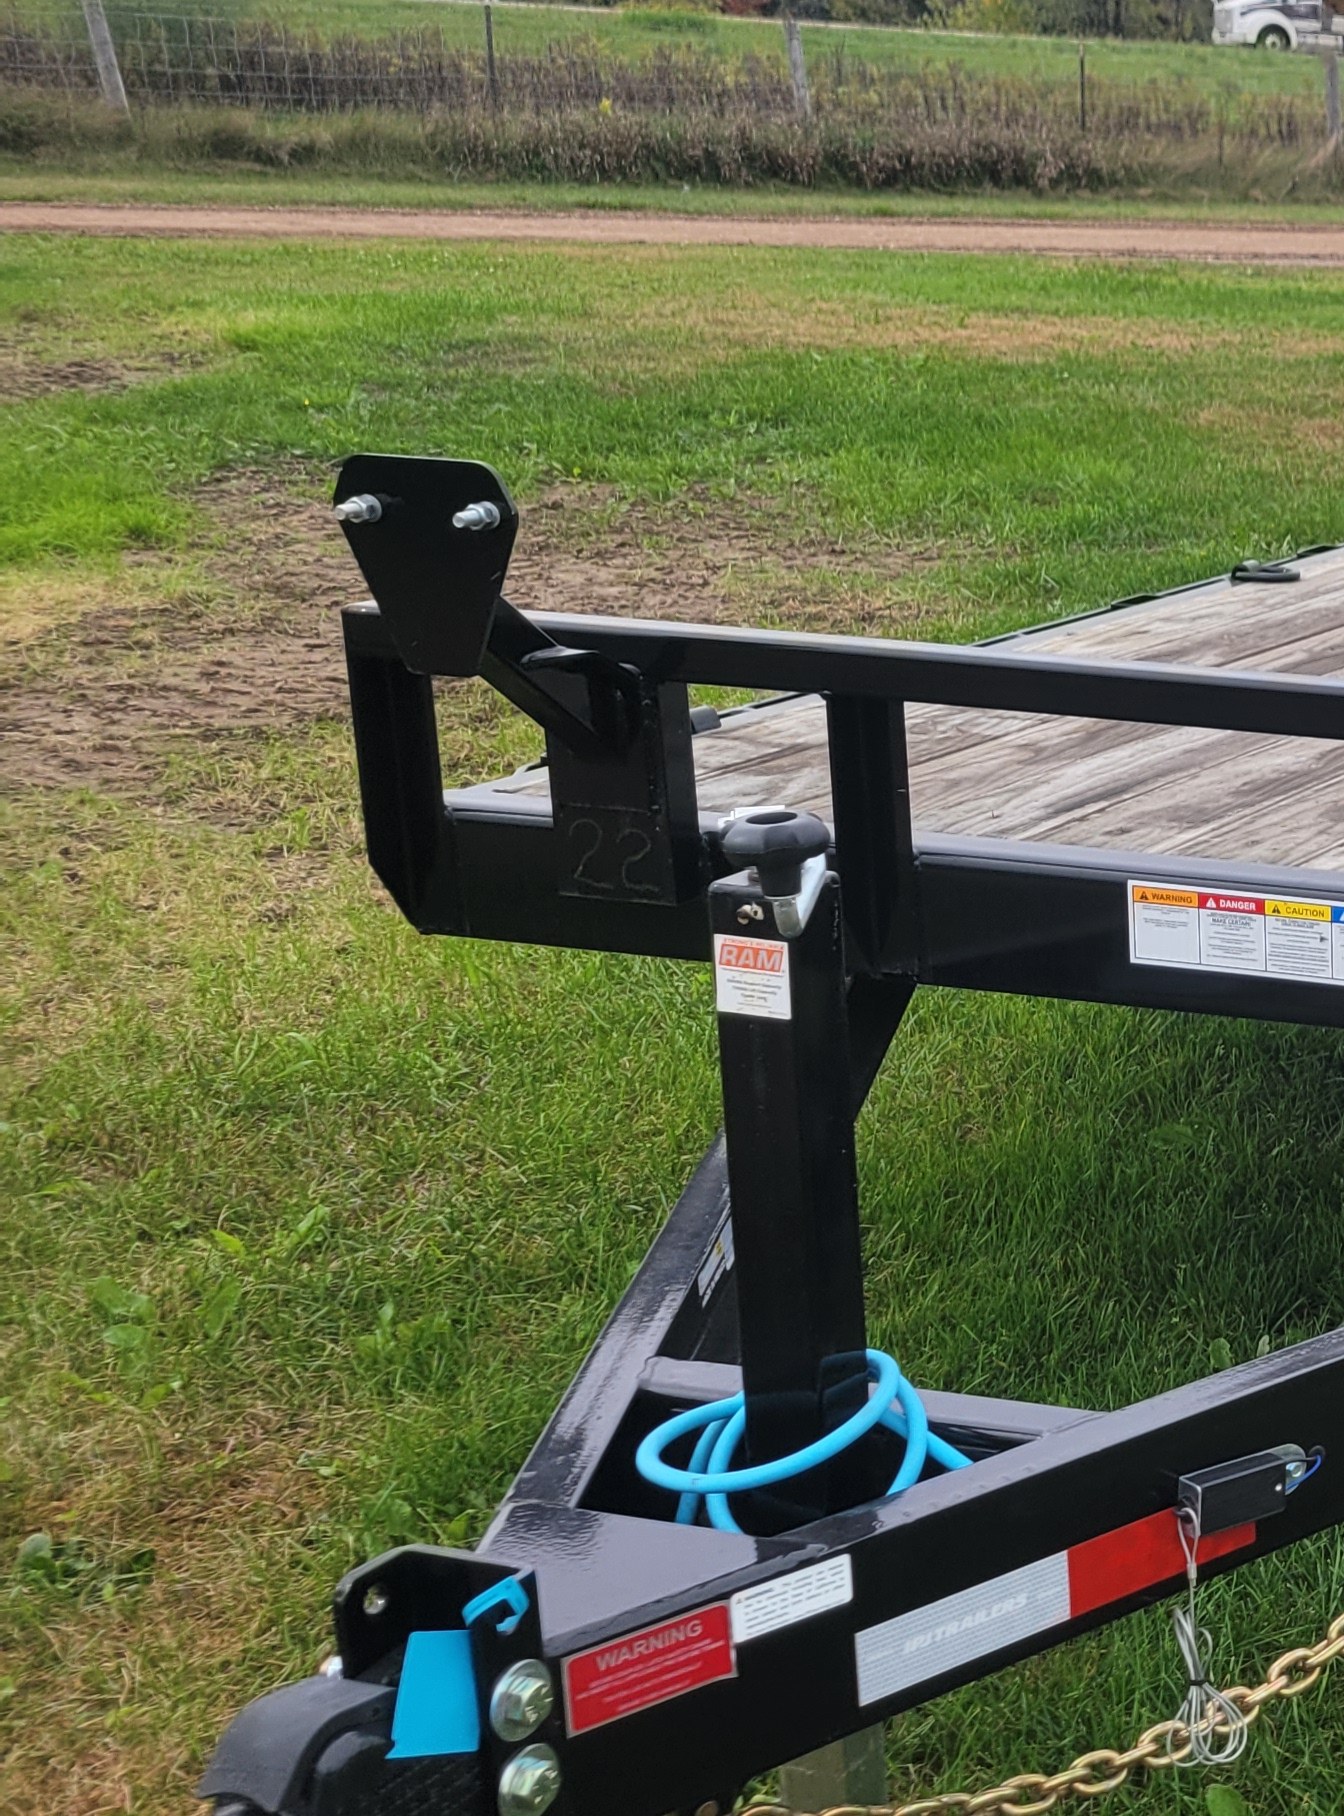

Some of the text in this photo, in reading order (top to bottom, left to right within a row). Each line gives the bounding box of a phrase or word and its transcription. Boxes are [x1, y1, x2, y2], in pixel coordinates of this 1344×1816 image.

[1151, 892, 1193, 904] WARNING
[1219, 898, 1257, 911] DANGER
[1285, 906, 1325, 918] CAUTION
[720, 944, 781, 971] RAM
[595, 1619, 703, 1671] WARNING
